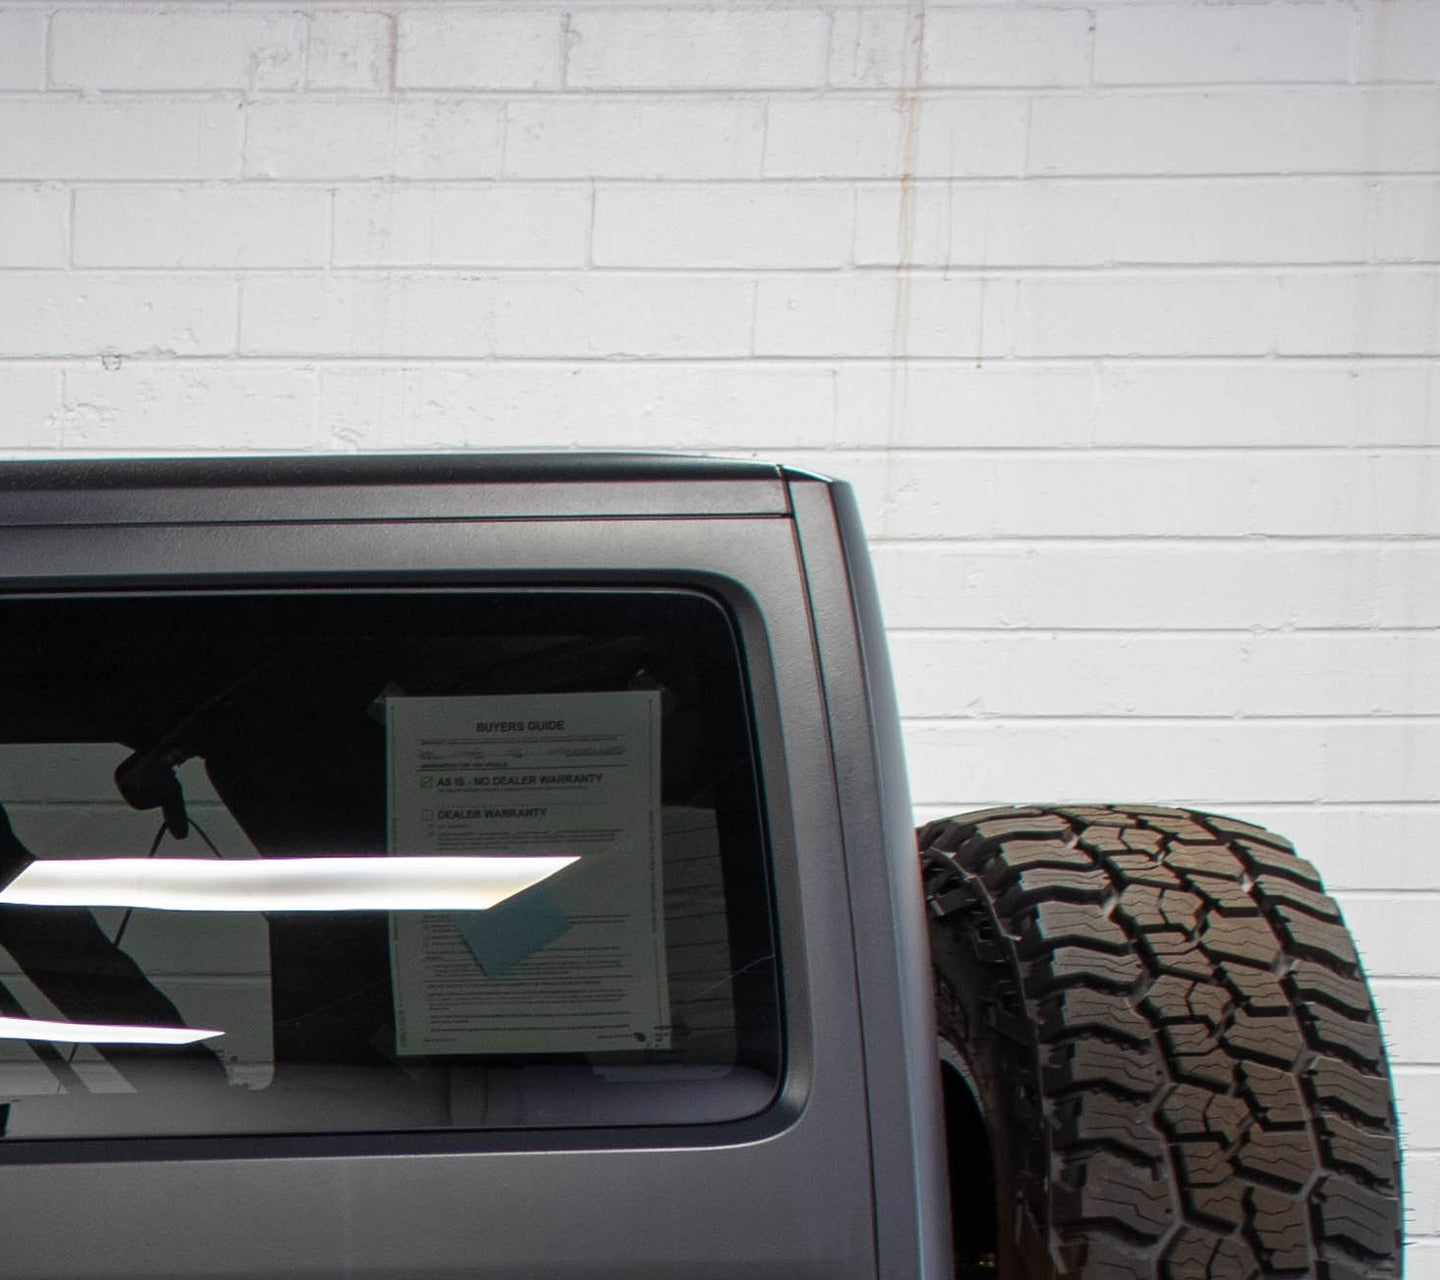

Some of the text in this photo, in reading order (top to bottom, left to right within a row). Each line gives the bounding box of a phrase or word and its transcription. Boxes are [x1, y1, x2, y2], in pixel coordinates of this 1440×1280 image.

[476, 719, 565, 733] BUYERS GUIDE
[436, 776, 453, 786] AS
[474, 776, 490, 786] NO
[492, 775, 537, 786] DEALER
[540, 773, 603, 785] WARRANTY
[438, 807, 548, 820] DEALER WARRANTY
